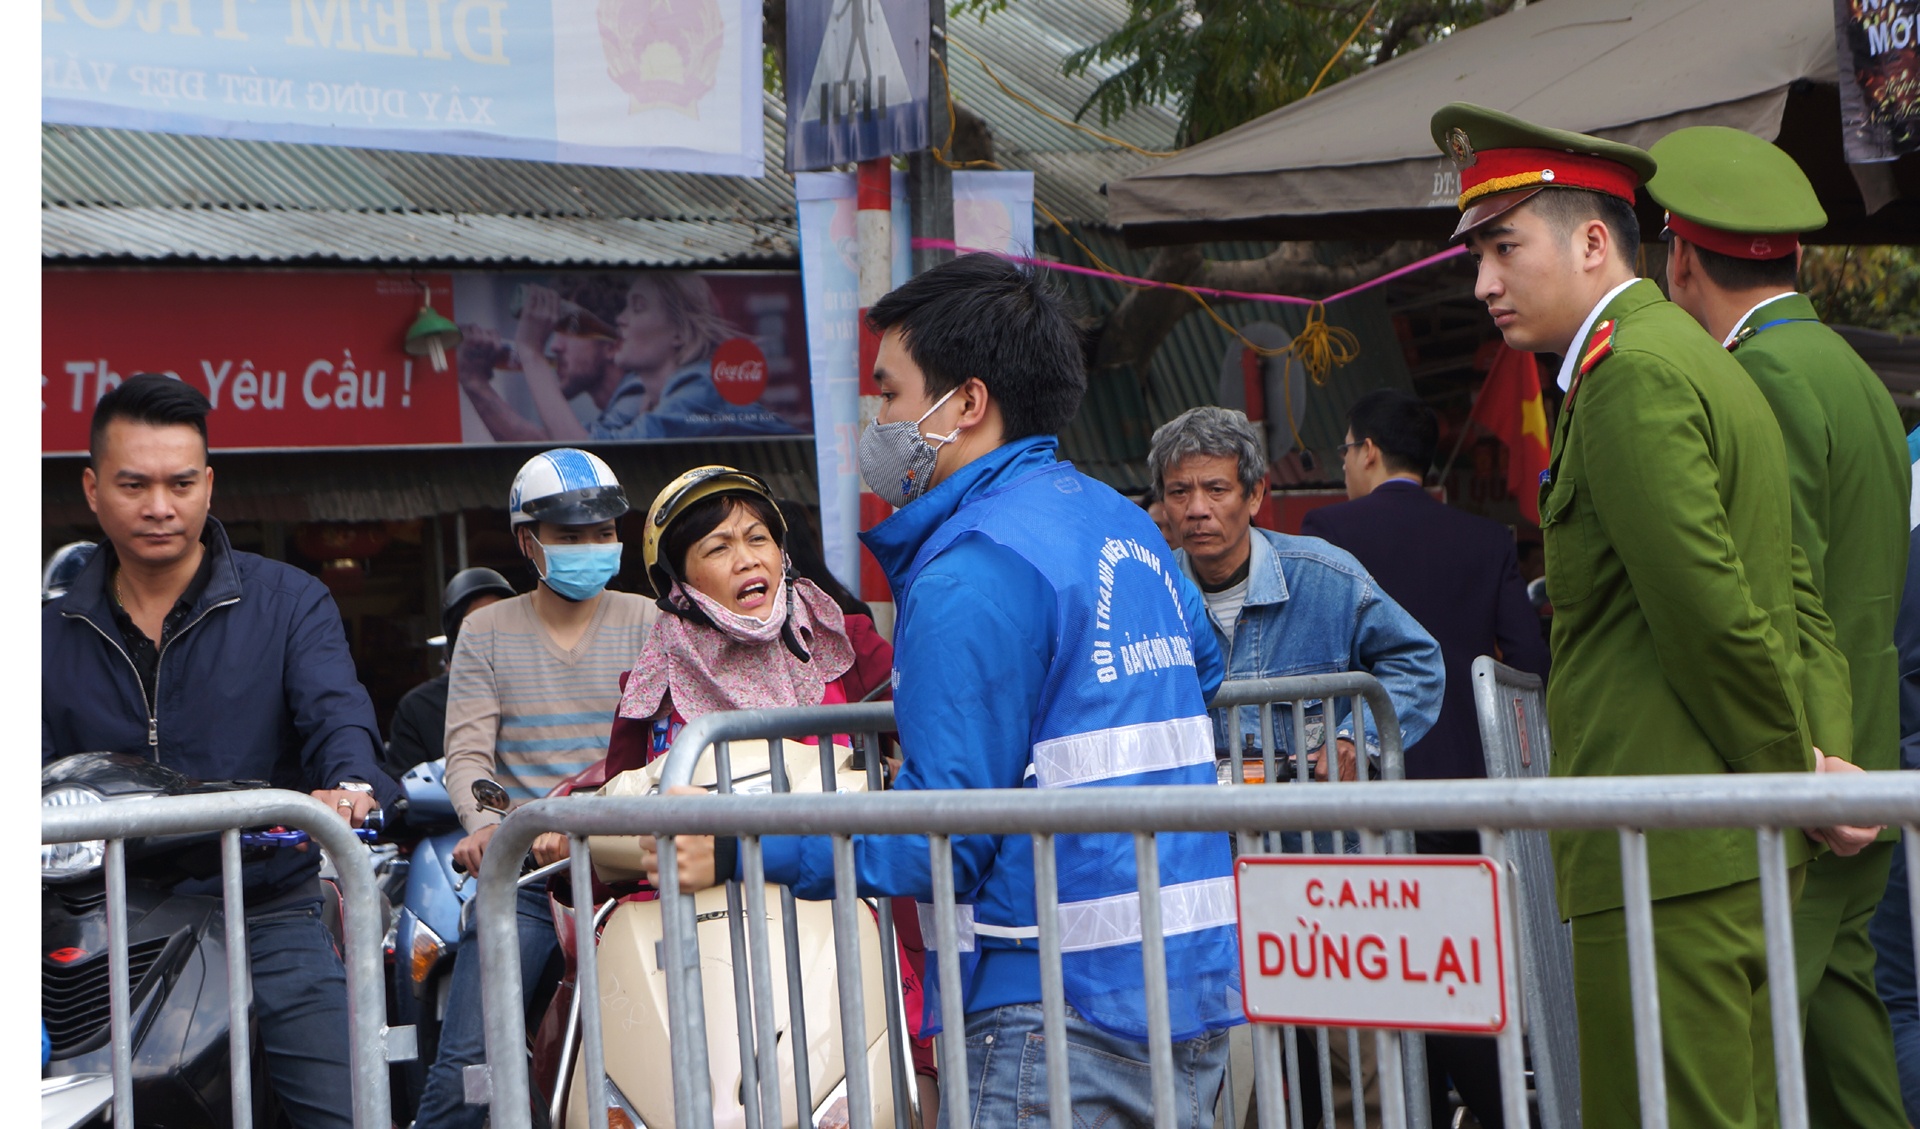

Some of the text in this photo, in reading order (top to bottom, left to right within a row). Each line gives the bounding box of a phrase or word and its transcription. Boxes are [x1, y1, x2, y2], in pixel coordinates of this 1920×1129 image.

[201, 359, 287, 410] Yêu
[302, 348, 387, 410] Cầu
[1096, 559, 1115, 630] THANH
[1306, 878, 1421, 909] C.A.H.N
[1257, 916, 1481, 996] DỪNG LẠI
